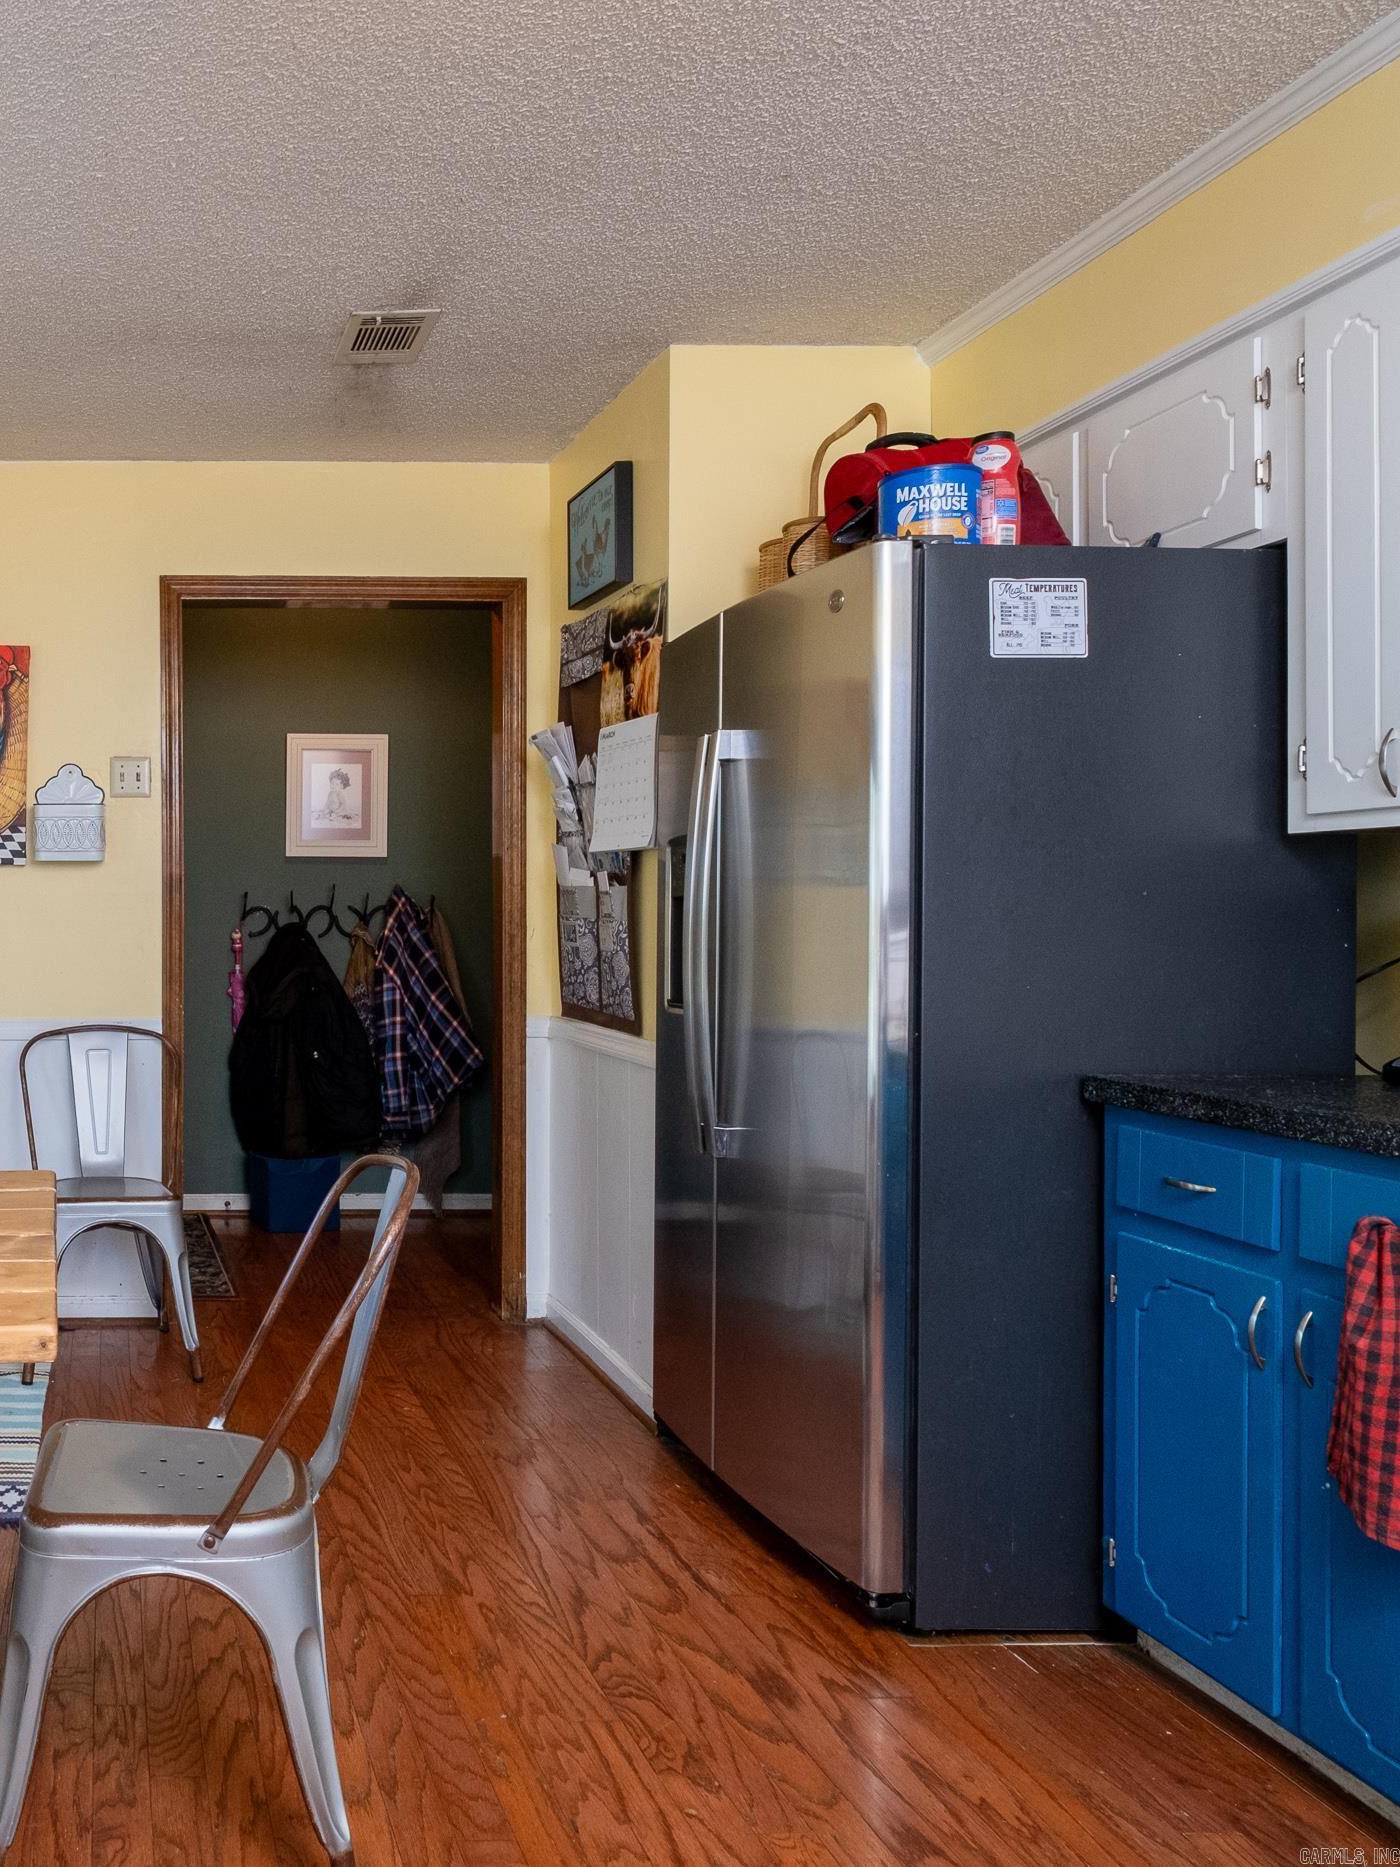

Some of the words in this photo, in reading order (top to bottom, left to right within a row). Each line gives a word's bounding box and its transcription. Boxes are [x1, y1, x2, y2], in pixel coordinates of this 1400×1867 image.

[897, 483, 968, 503] MAXWELL
[919, 497, 968, 513] HOUSE
[1024, 583, 1078, 593] TEMPERATURES
